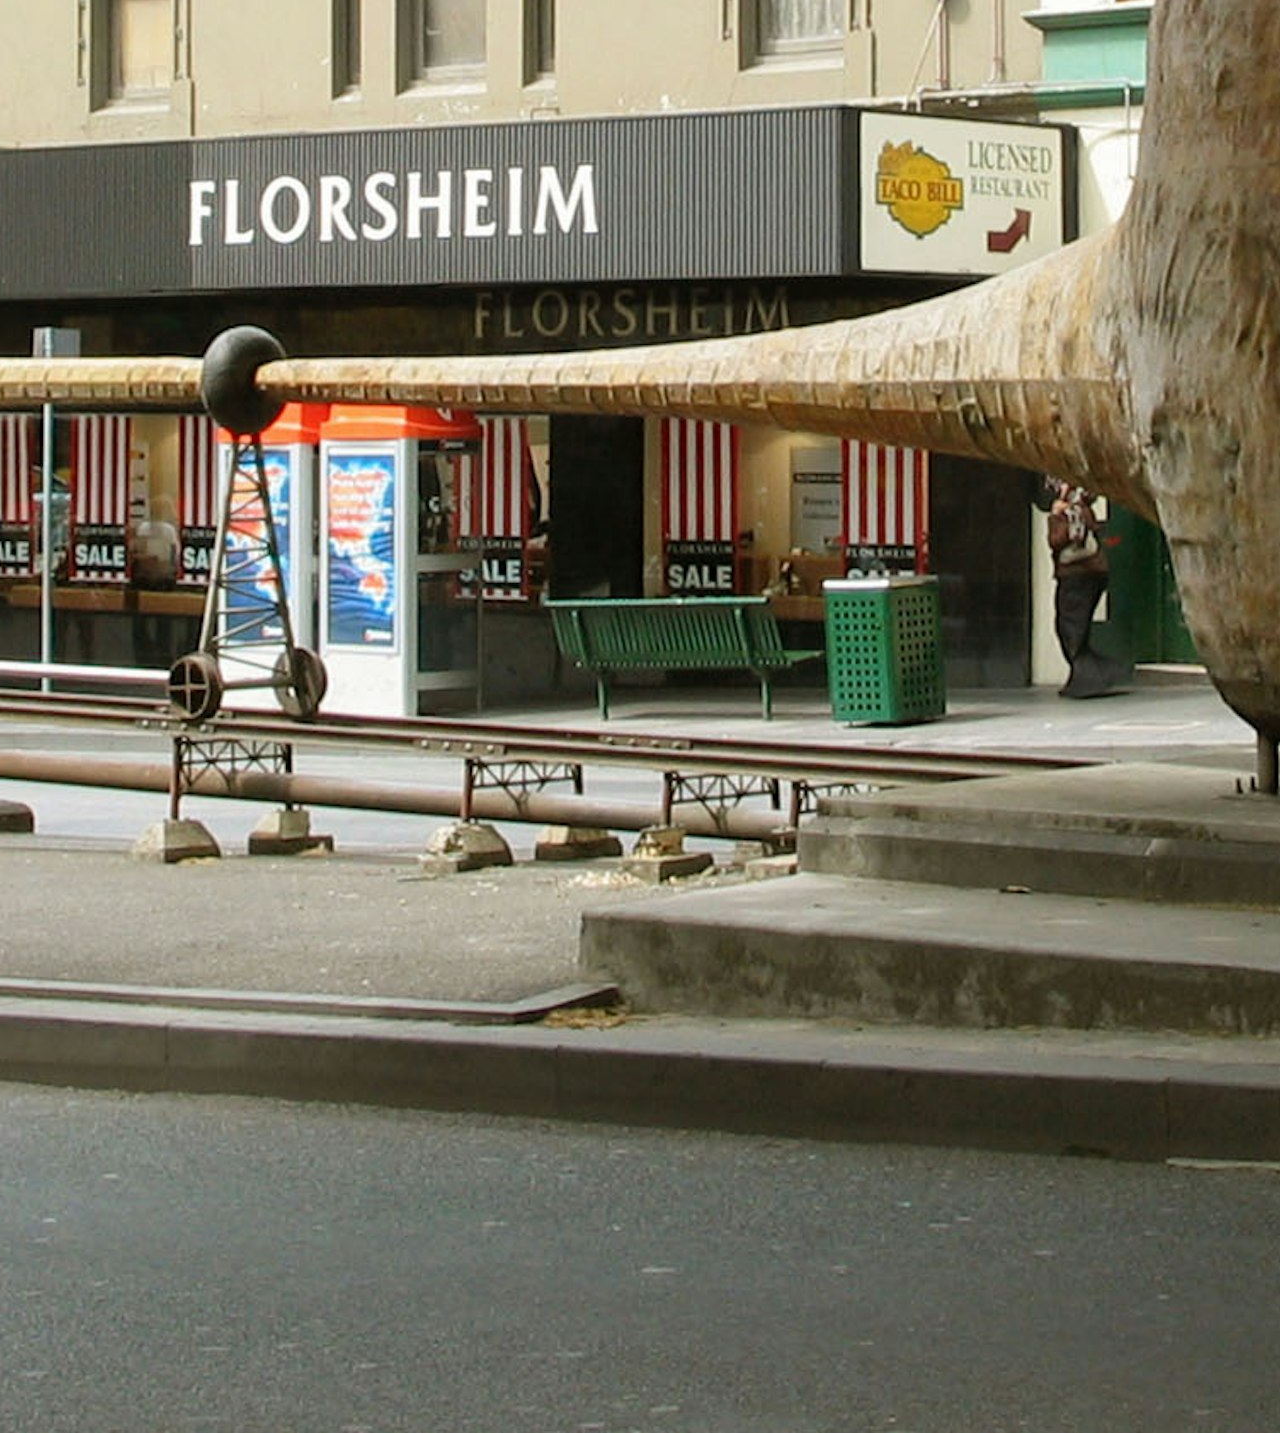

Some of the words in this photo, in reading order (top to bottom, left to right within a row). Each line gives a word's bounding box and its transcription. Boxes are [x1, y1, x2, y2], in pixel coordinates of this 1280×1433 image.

[968, 140, 1053, 174] LICENSED
[881, 178, 920, 200] TACO
[927, 181, 958, 203] BILL
[970, 175, 1051, 200] RESTAURANT
[188, 165, 599, 246] FLORSHEIM
[473, 286, 791, 339] FLORSHEIM
[75, 544, 125, 567] SALE
[183, 546, 215, 570] SA
[669, 564, 732, 589] SALE
